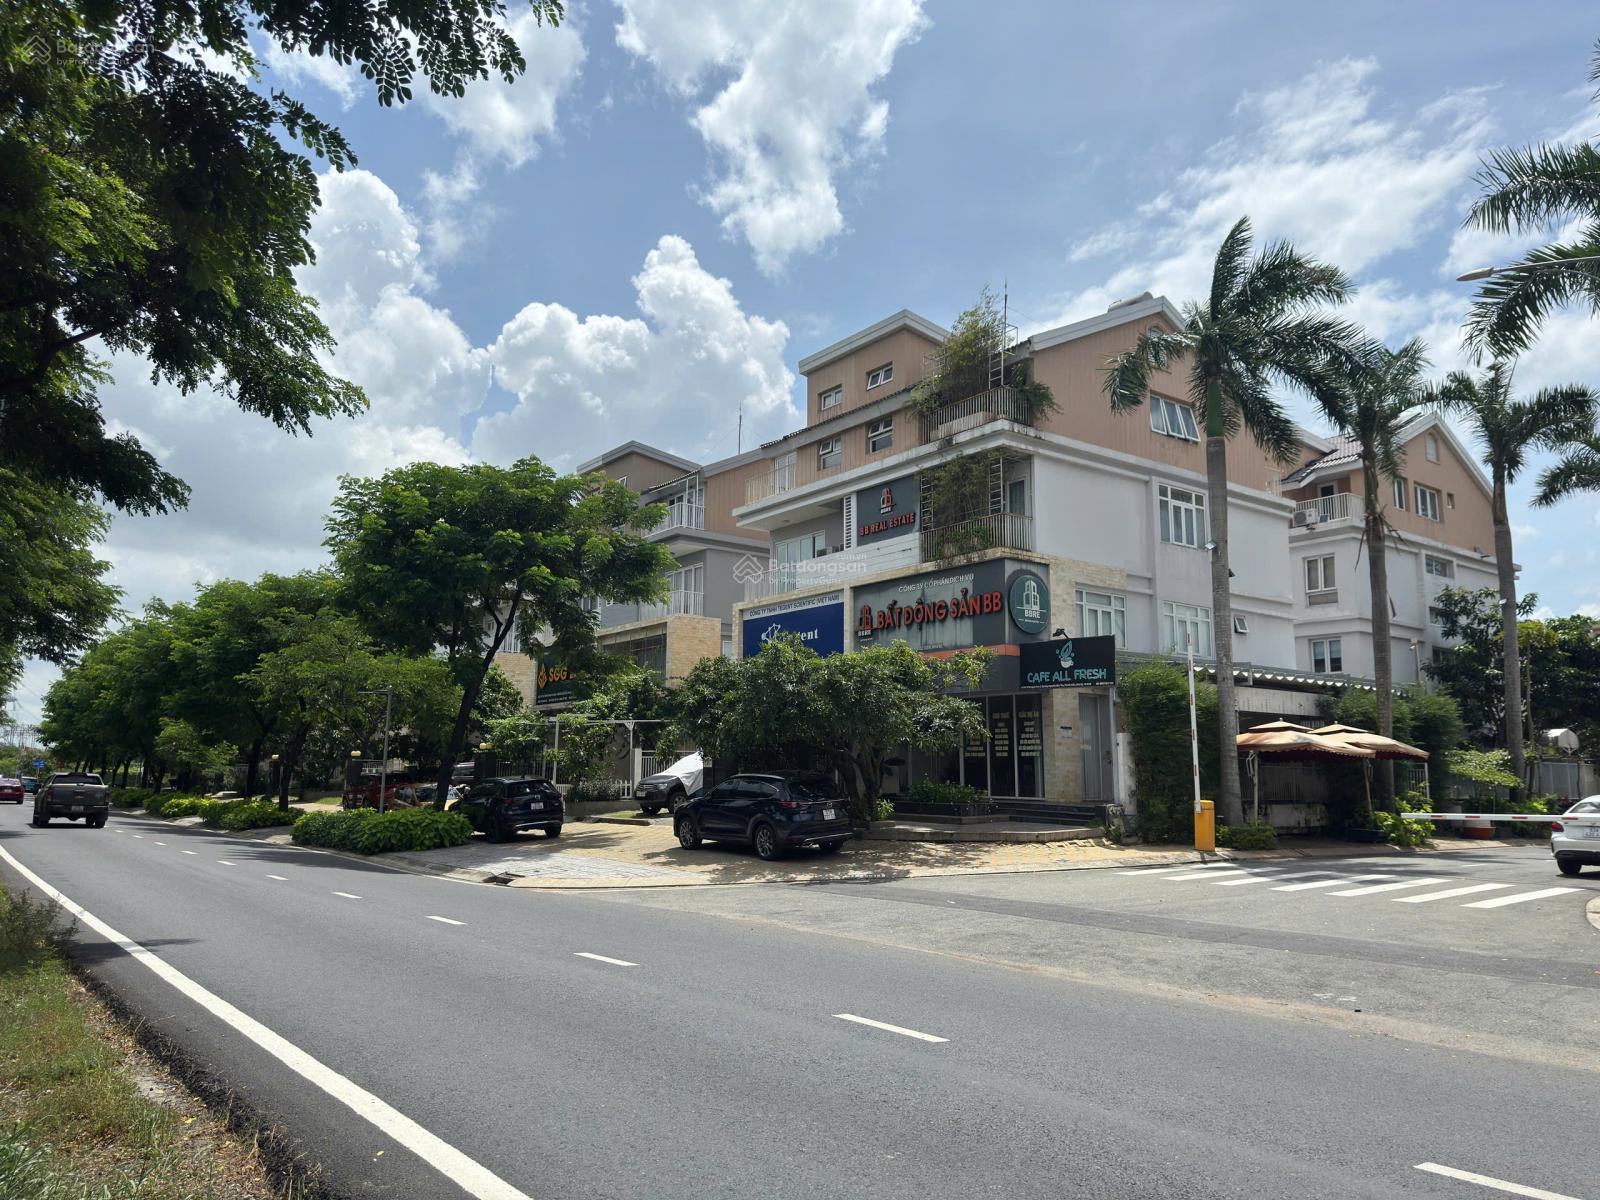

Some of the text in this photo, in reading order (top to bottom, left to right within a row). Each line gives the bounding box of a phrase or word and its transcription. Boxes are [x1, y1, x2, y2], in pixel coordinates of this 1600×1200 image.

[870, 521, 888, 533] REAL
[889, 512, 916, 528] ESTATE
[793, 598, 816, 609] SCIENTIFIC
[949, 587, 981, 619] SẢN
[982, 591, 1003, 614] BB
[1024, 609, 1041, 619] BBRE
[1027, 668, 1107, 683] CAFE ALL FRESH
